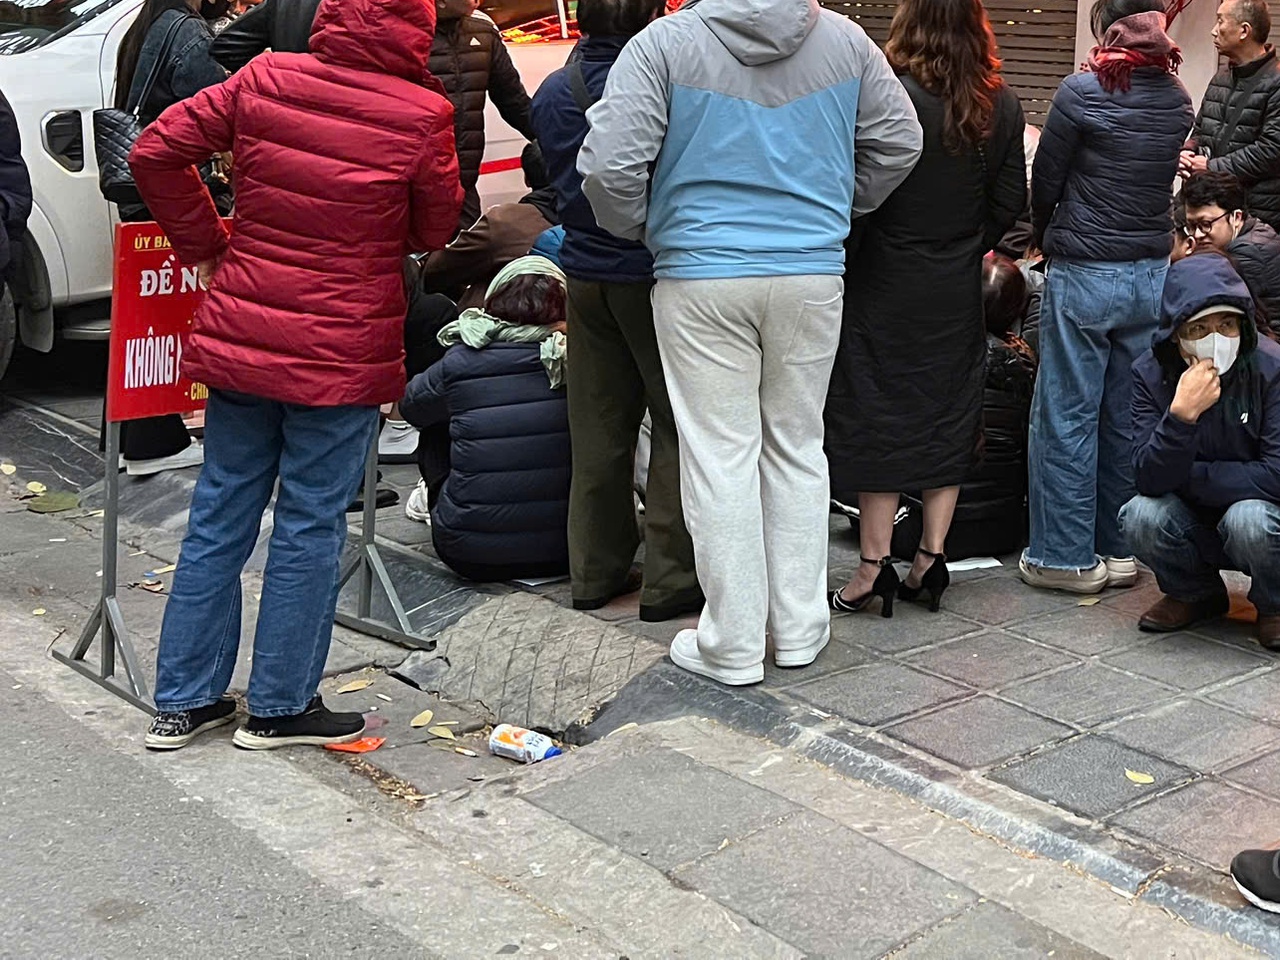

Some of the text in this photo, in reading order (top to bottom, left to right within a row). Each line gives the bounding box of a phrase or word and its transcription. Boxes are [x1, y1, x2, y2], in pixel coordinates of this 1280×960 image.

[139, 253, 207, 297] ĐỀ N
[124, 326, 174, 389] KHÔNG
